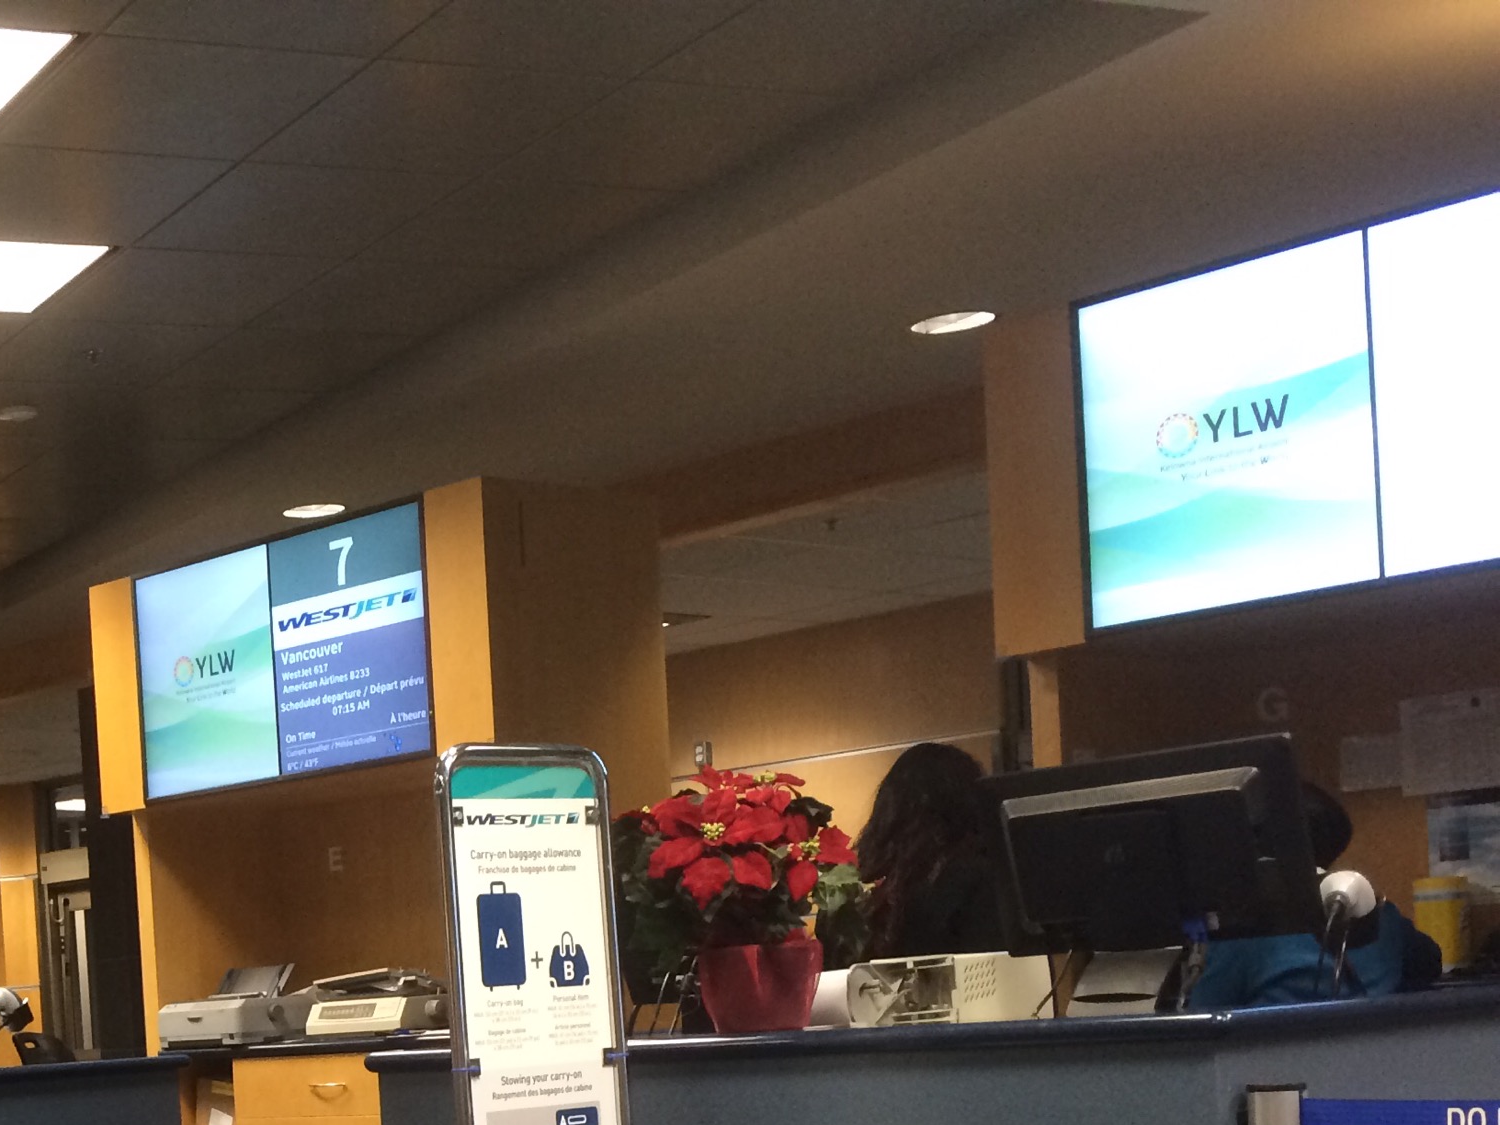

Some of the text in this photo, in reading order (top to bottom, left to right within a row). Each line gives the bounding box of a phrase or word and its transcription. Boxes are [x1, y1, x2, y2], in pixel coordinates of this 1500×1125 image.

[1202, 394, 1289, 443] YLW
[329, 536, 354, 586] 7
[278, 592, 402, 632] WESTJET
[196, 649, 235, 678] YLW
[280, 641, 344, 666] Vancouver
[282, 663, 328, 681] WestJet 617
[283, 680, 318, 694] American
[320, 672, 348, 686] Airlines
[280, 695, 320, 712] Scheduled
[322, 688, 362, 705] departure
[370, 680, 398, 694] Départ
[400, 676, 424, 691] prévu
[332, 700, 370, 716] 07:15 AM
[398, 709, 426, 722] l'heure
[1256, 688, 1289, 722] G
[286, 730, 316, 744] On Time
[466, 813, 566, 828] WESTJET
[470, 848, 582, 862] Carry-on baggage allowance
[478, 864, 576, 874] Franchise de bagages de cabine
[496, 928, 508, 949] A
[564, 960, 574, 981] B
[501, 1070, 582, 1086] Stowing your carry-on
[492, 1089, 527, 1101] Rangement
[528, 1088, 538, 1097] des
[540, 1086, 564, 1096] bagages
[574, 1084, 592, 1092] cabine
